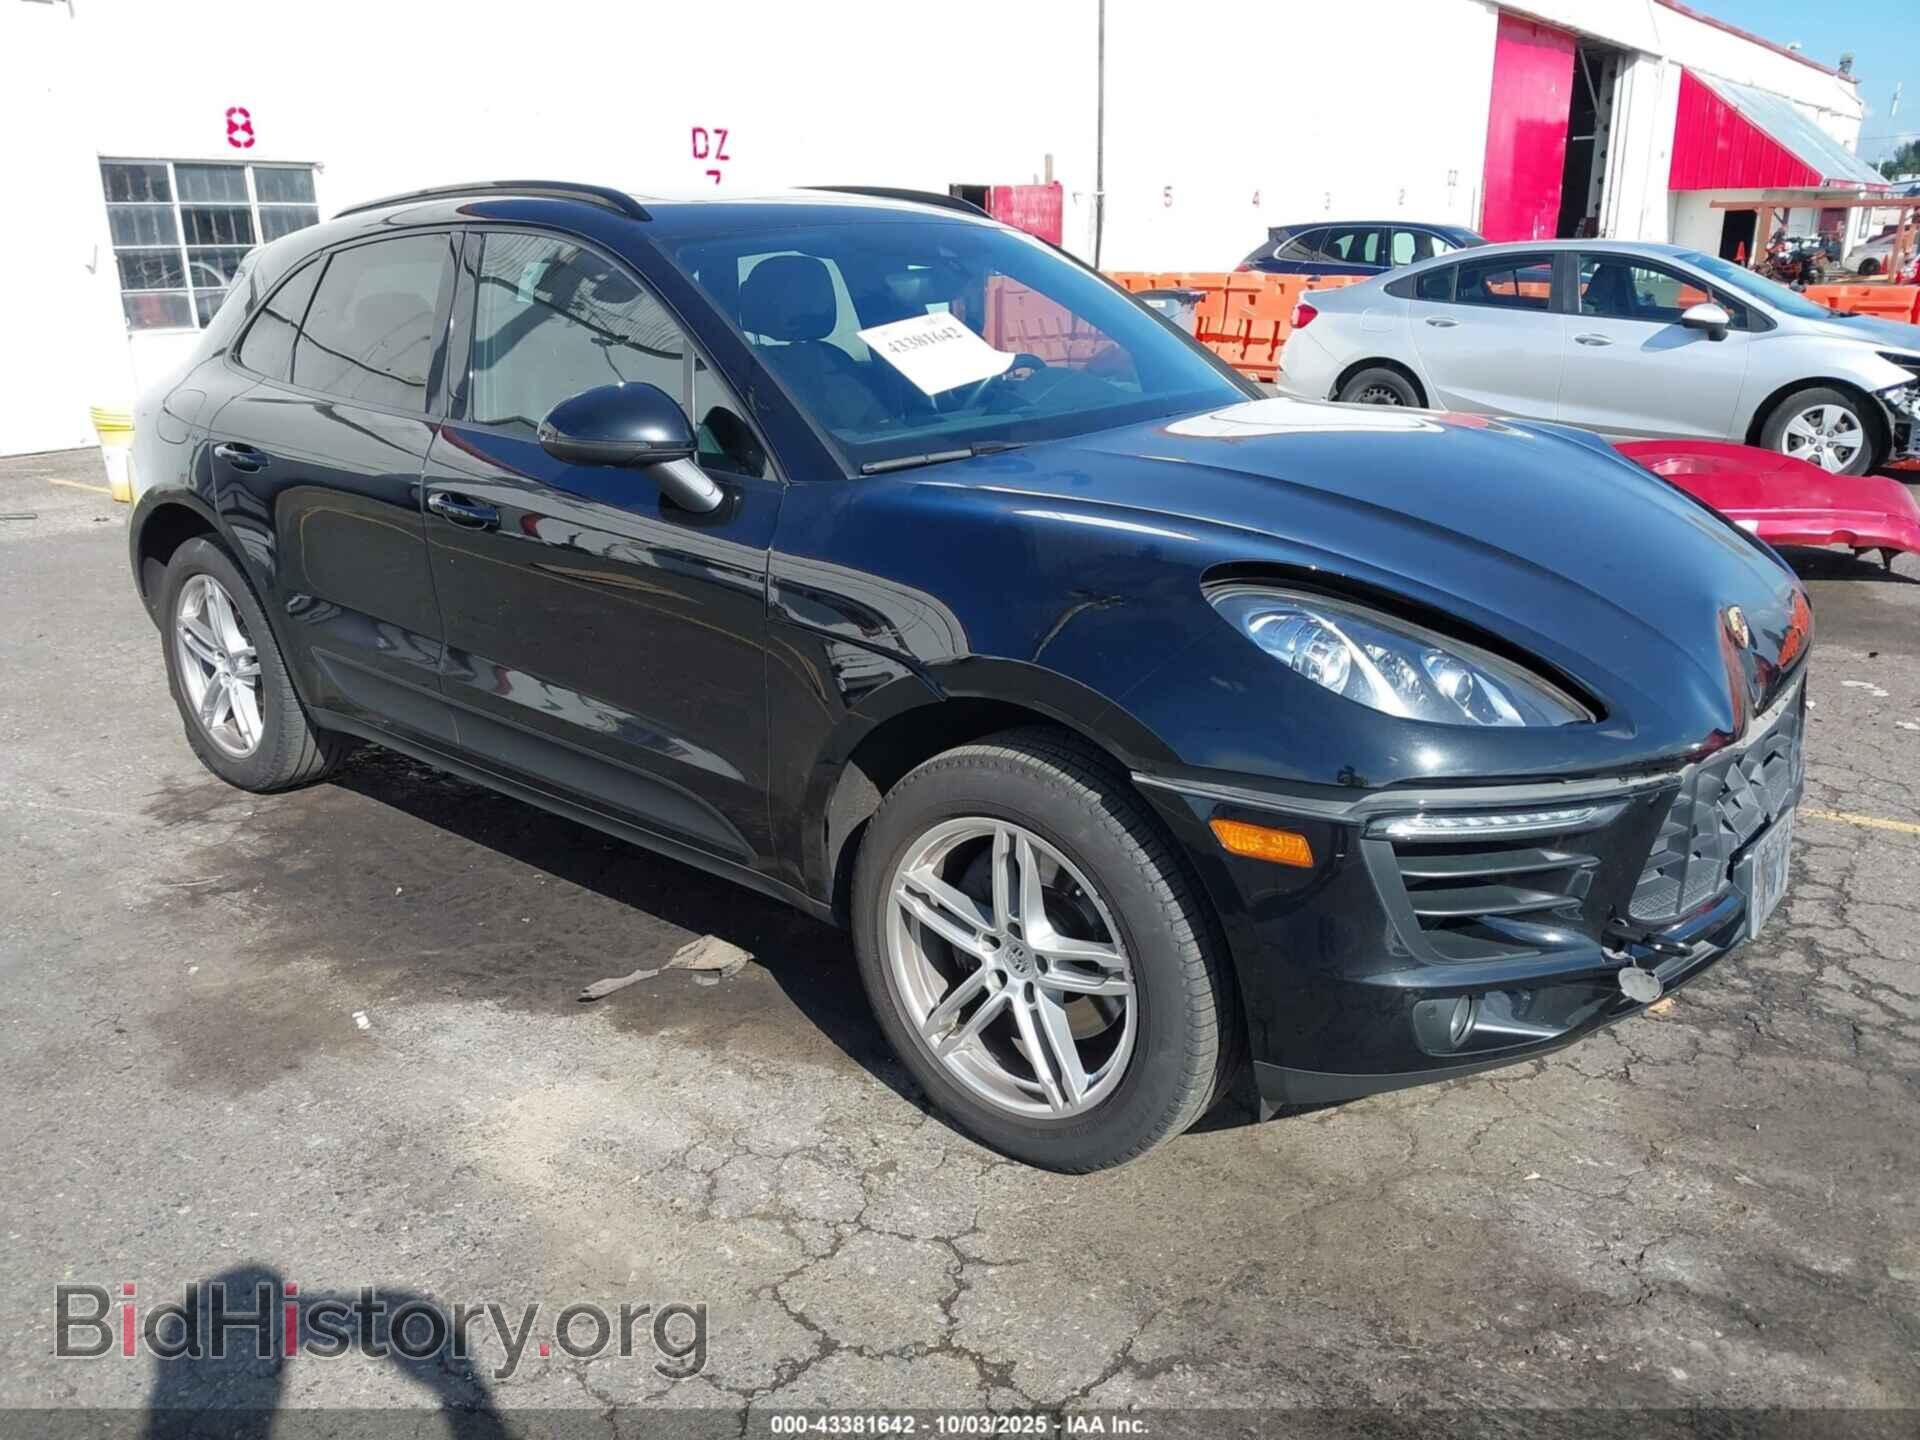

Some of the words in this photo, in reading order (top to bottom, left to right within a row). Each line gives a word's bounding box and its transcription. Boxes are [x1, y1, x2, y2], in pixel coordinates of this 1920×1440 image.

[225, 106, 255, 149] 8
[691, 126, 731, 161] DZ
[1163, 185, 1173, 208] 5
[1252, 190, 1261, 208] 4
[888, 326, 963, 353] 43381642
